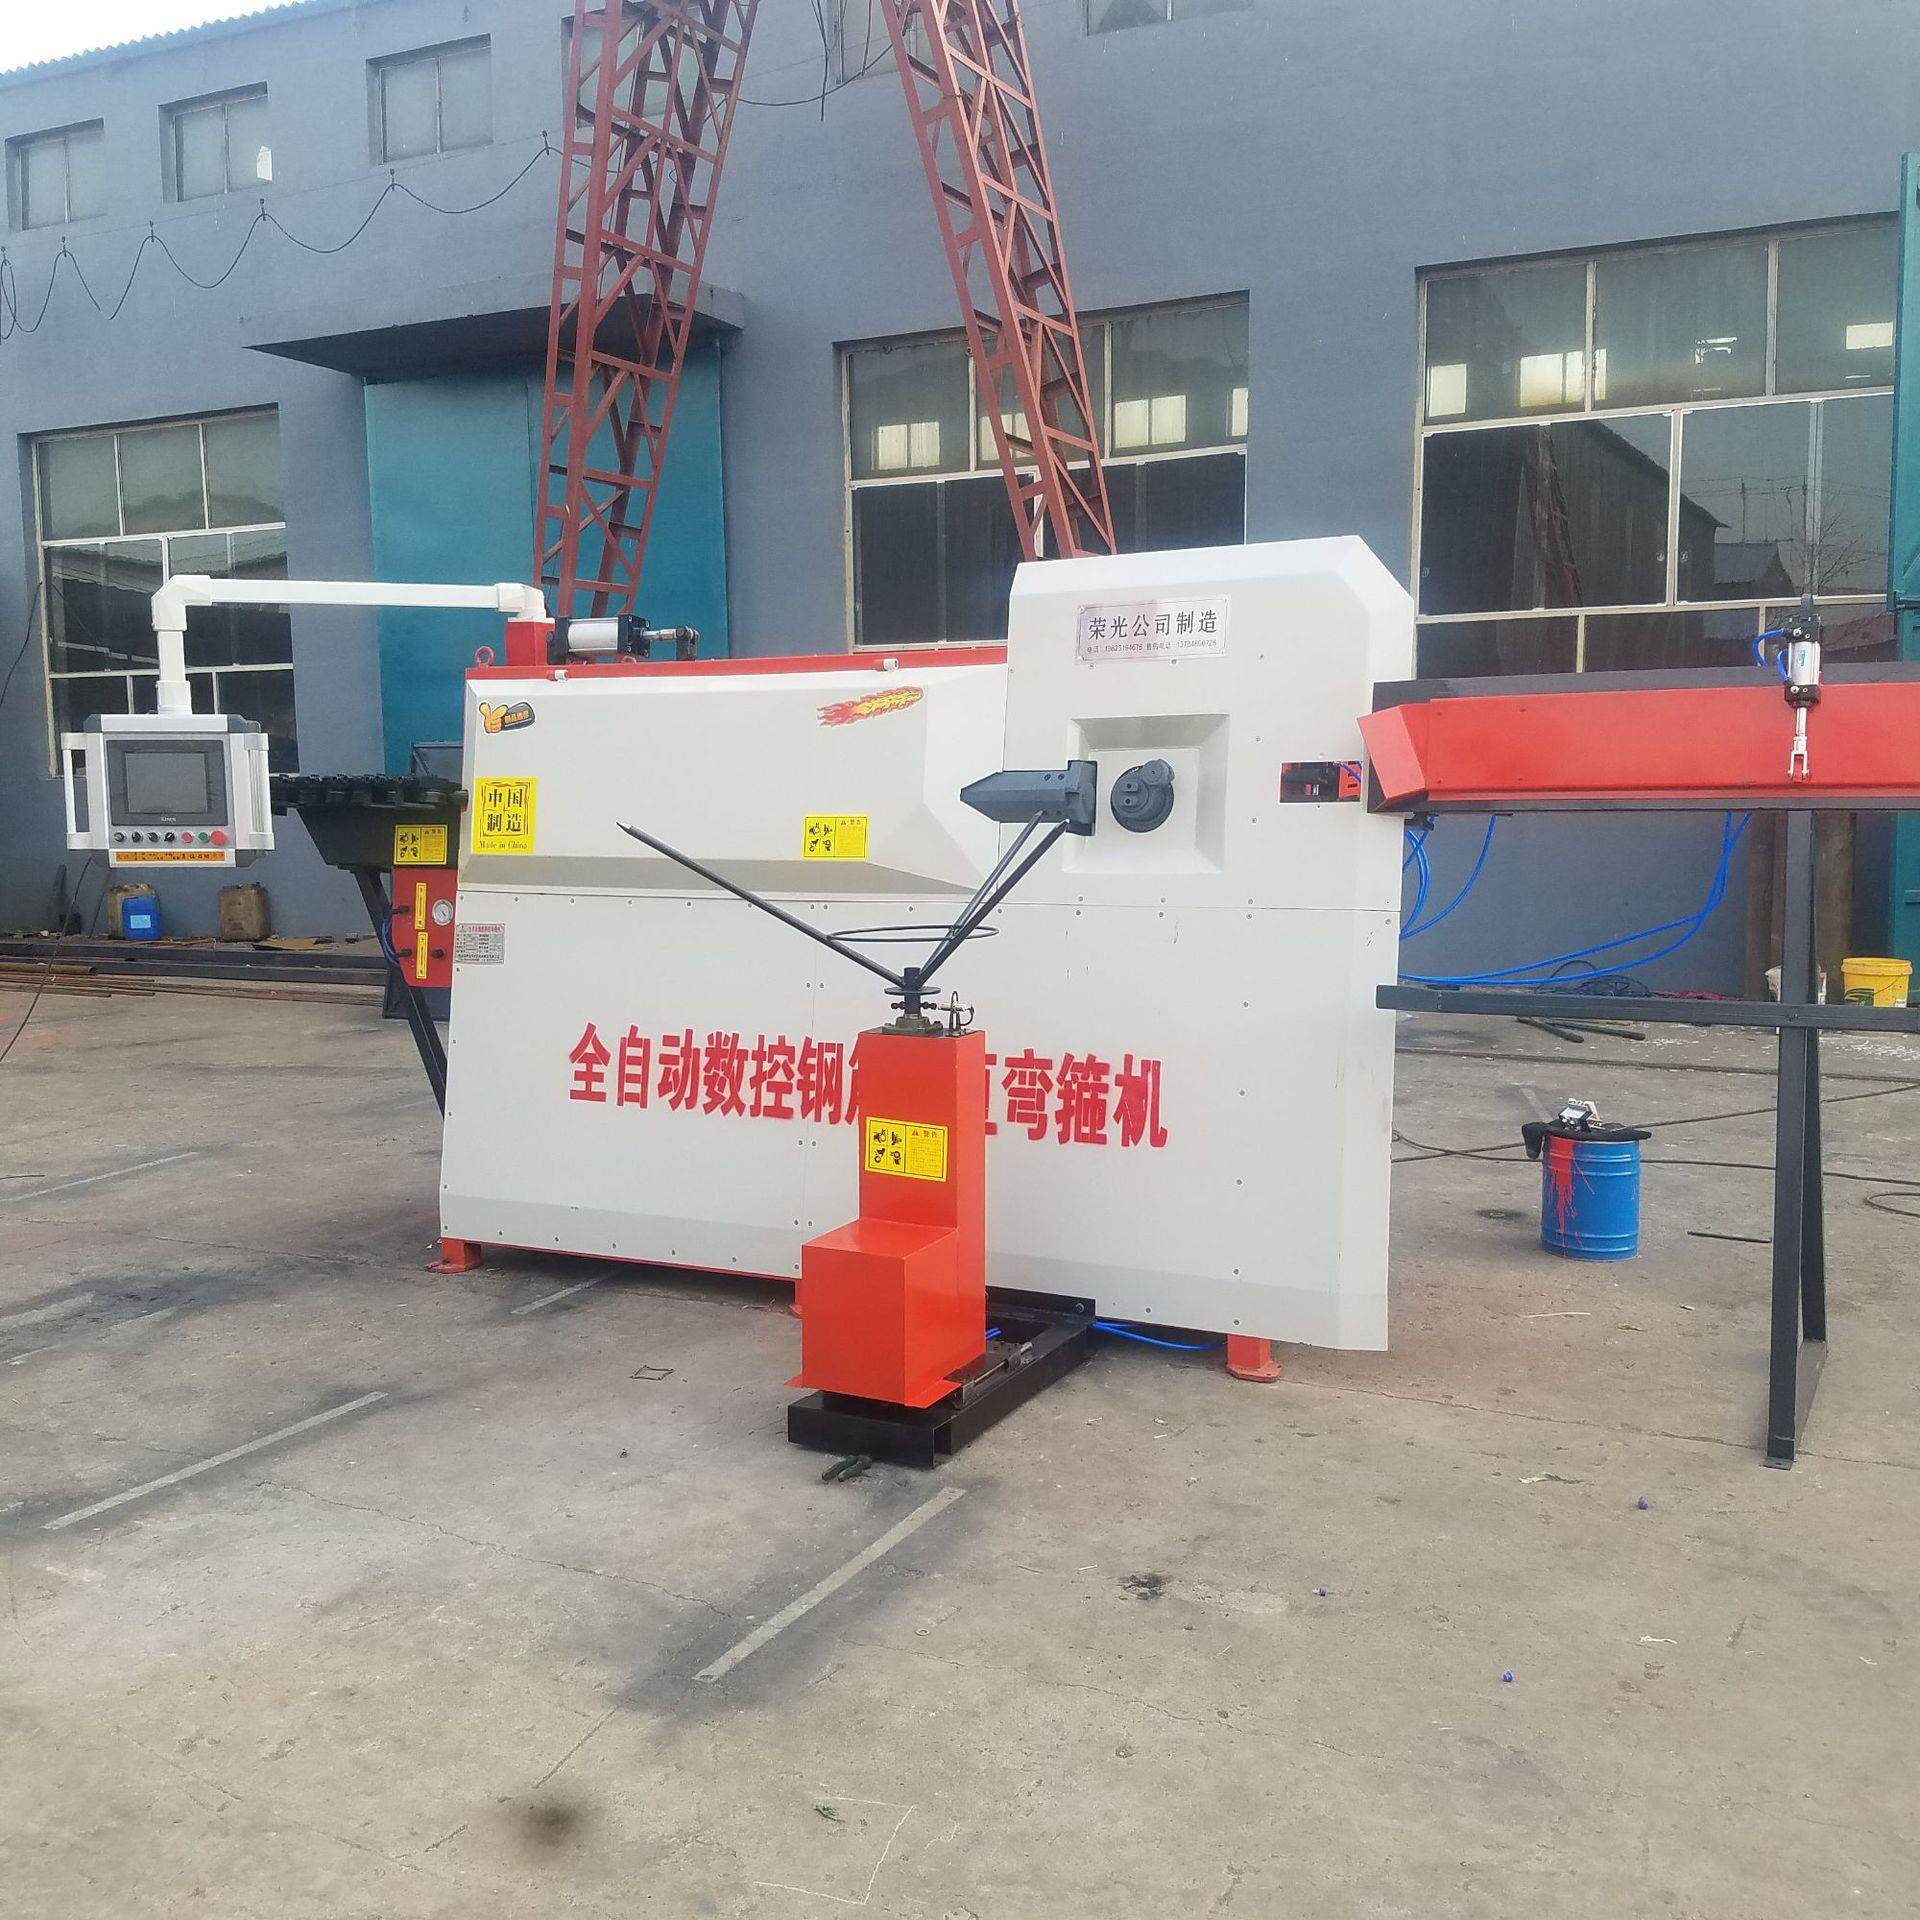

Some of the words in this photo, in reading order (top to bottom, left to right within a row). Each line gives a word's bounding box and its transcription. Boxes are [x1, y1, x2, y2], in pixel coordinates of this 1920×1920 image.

[1088, 609, 1217, 640] 荣光公司制造
[488, 788, 523, 808] 中国
[487, 813, 522, 832] 制造
[508, 840, 527, 849] China
[569, 1022, 1168, 1148] 全自动数控钢弯箍机
